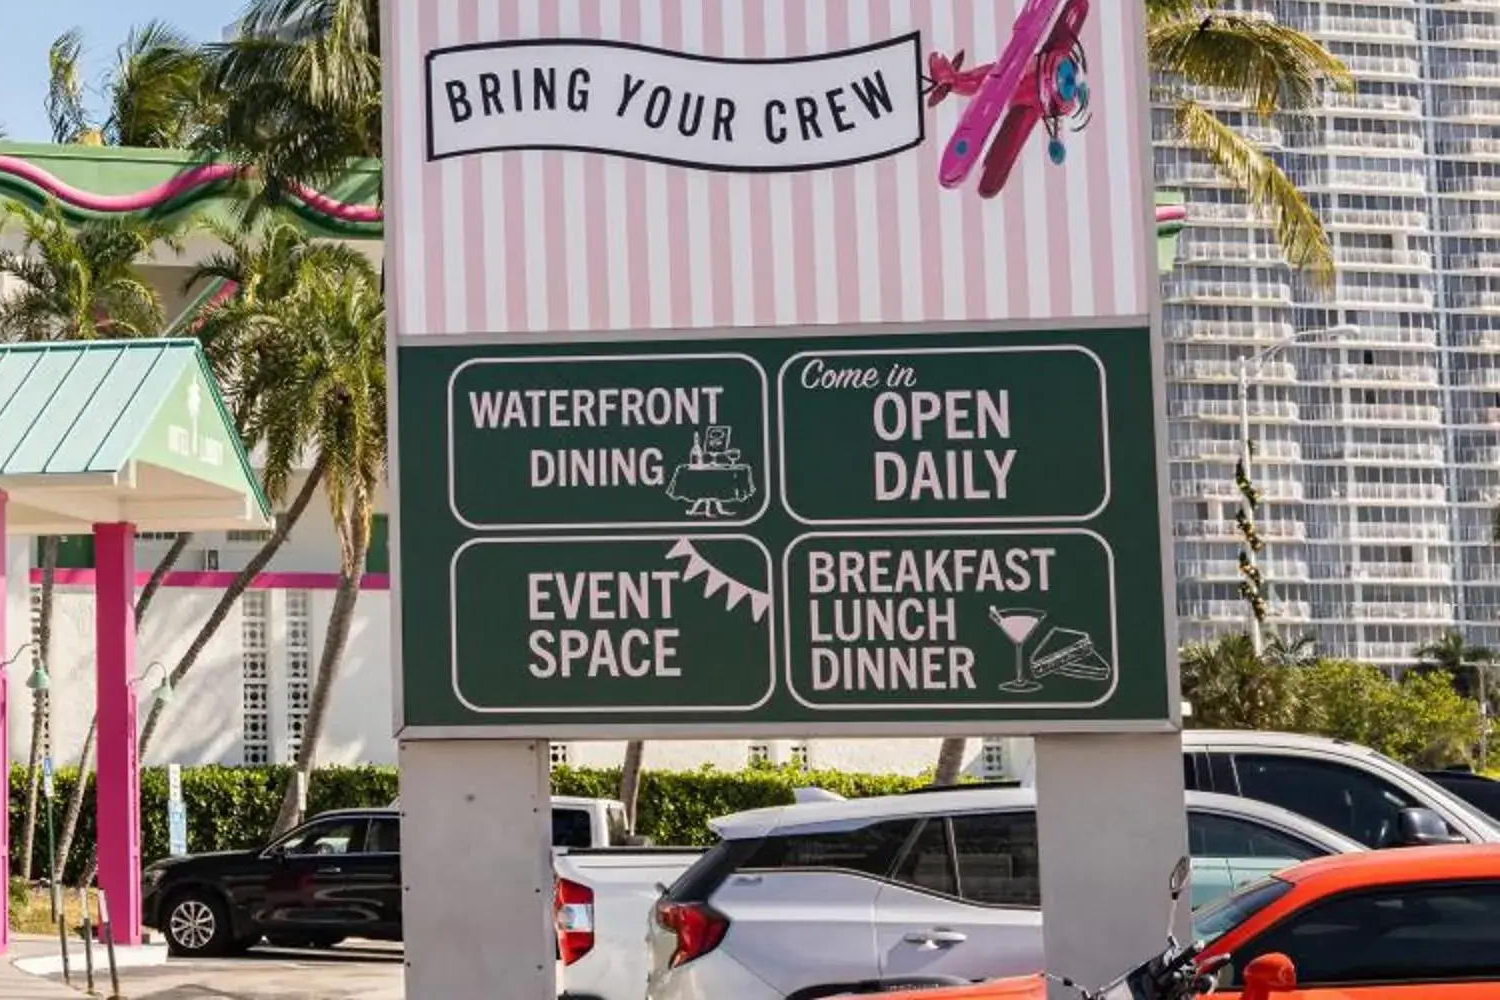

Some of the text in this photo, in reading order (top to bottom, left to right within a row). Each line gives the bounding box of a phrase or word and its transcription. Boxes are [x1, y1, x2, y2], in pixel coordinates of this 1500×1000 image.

[445, 67, 894, 146] BRING YOUR CREW
[801, 358, 918, 390] Come in
[468, 386, 724, 429] WATERFRONT
[873, 389, 1010, 441] OPEN
[530, 447, 664, 488] DINING
[874, 449, 1017, 501] DAILY
[808, 547, 1056, 593] BREAKFAST
[528, 570, 680, 621] EVENT
[809, 597, 957, 642] LUNCH
[528, 628, 682, 678] SPACE
[811, 646, 977, 691] DINNER
